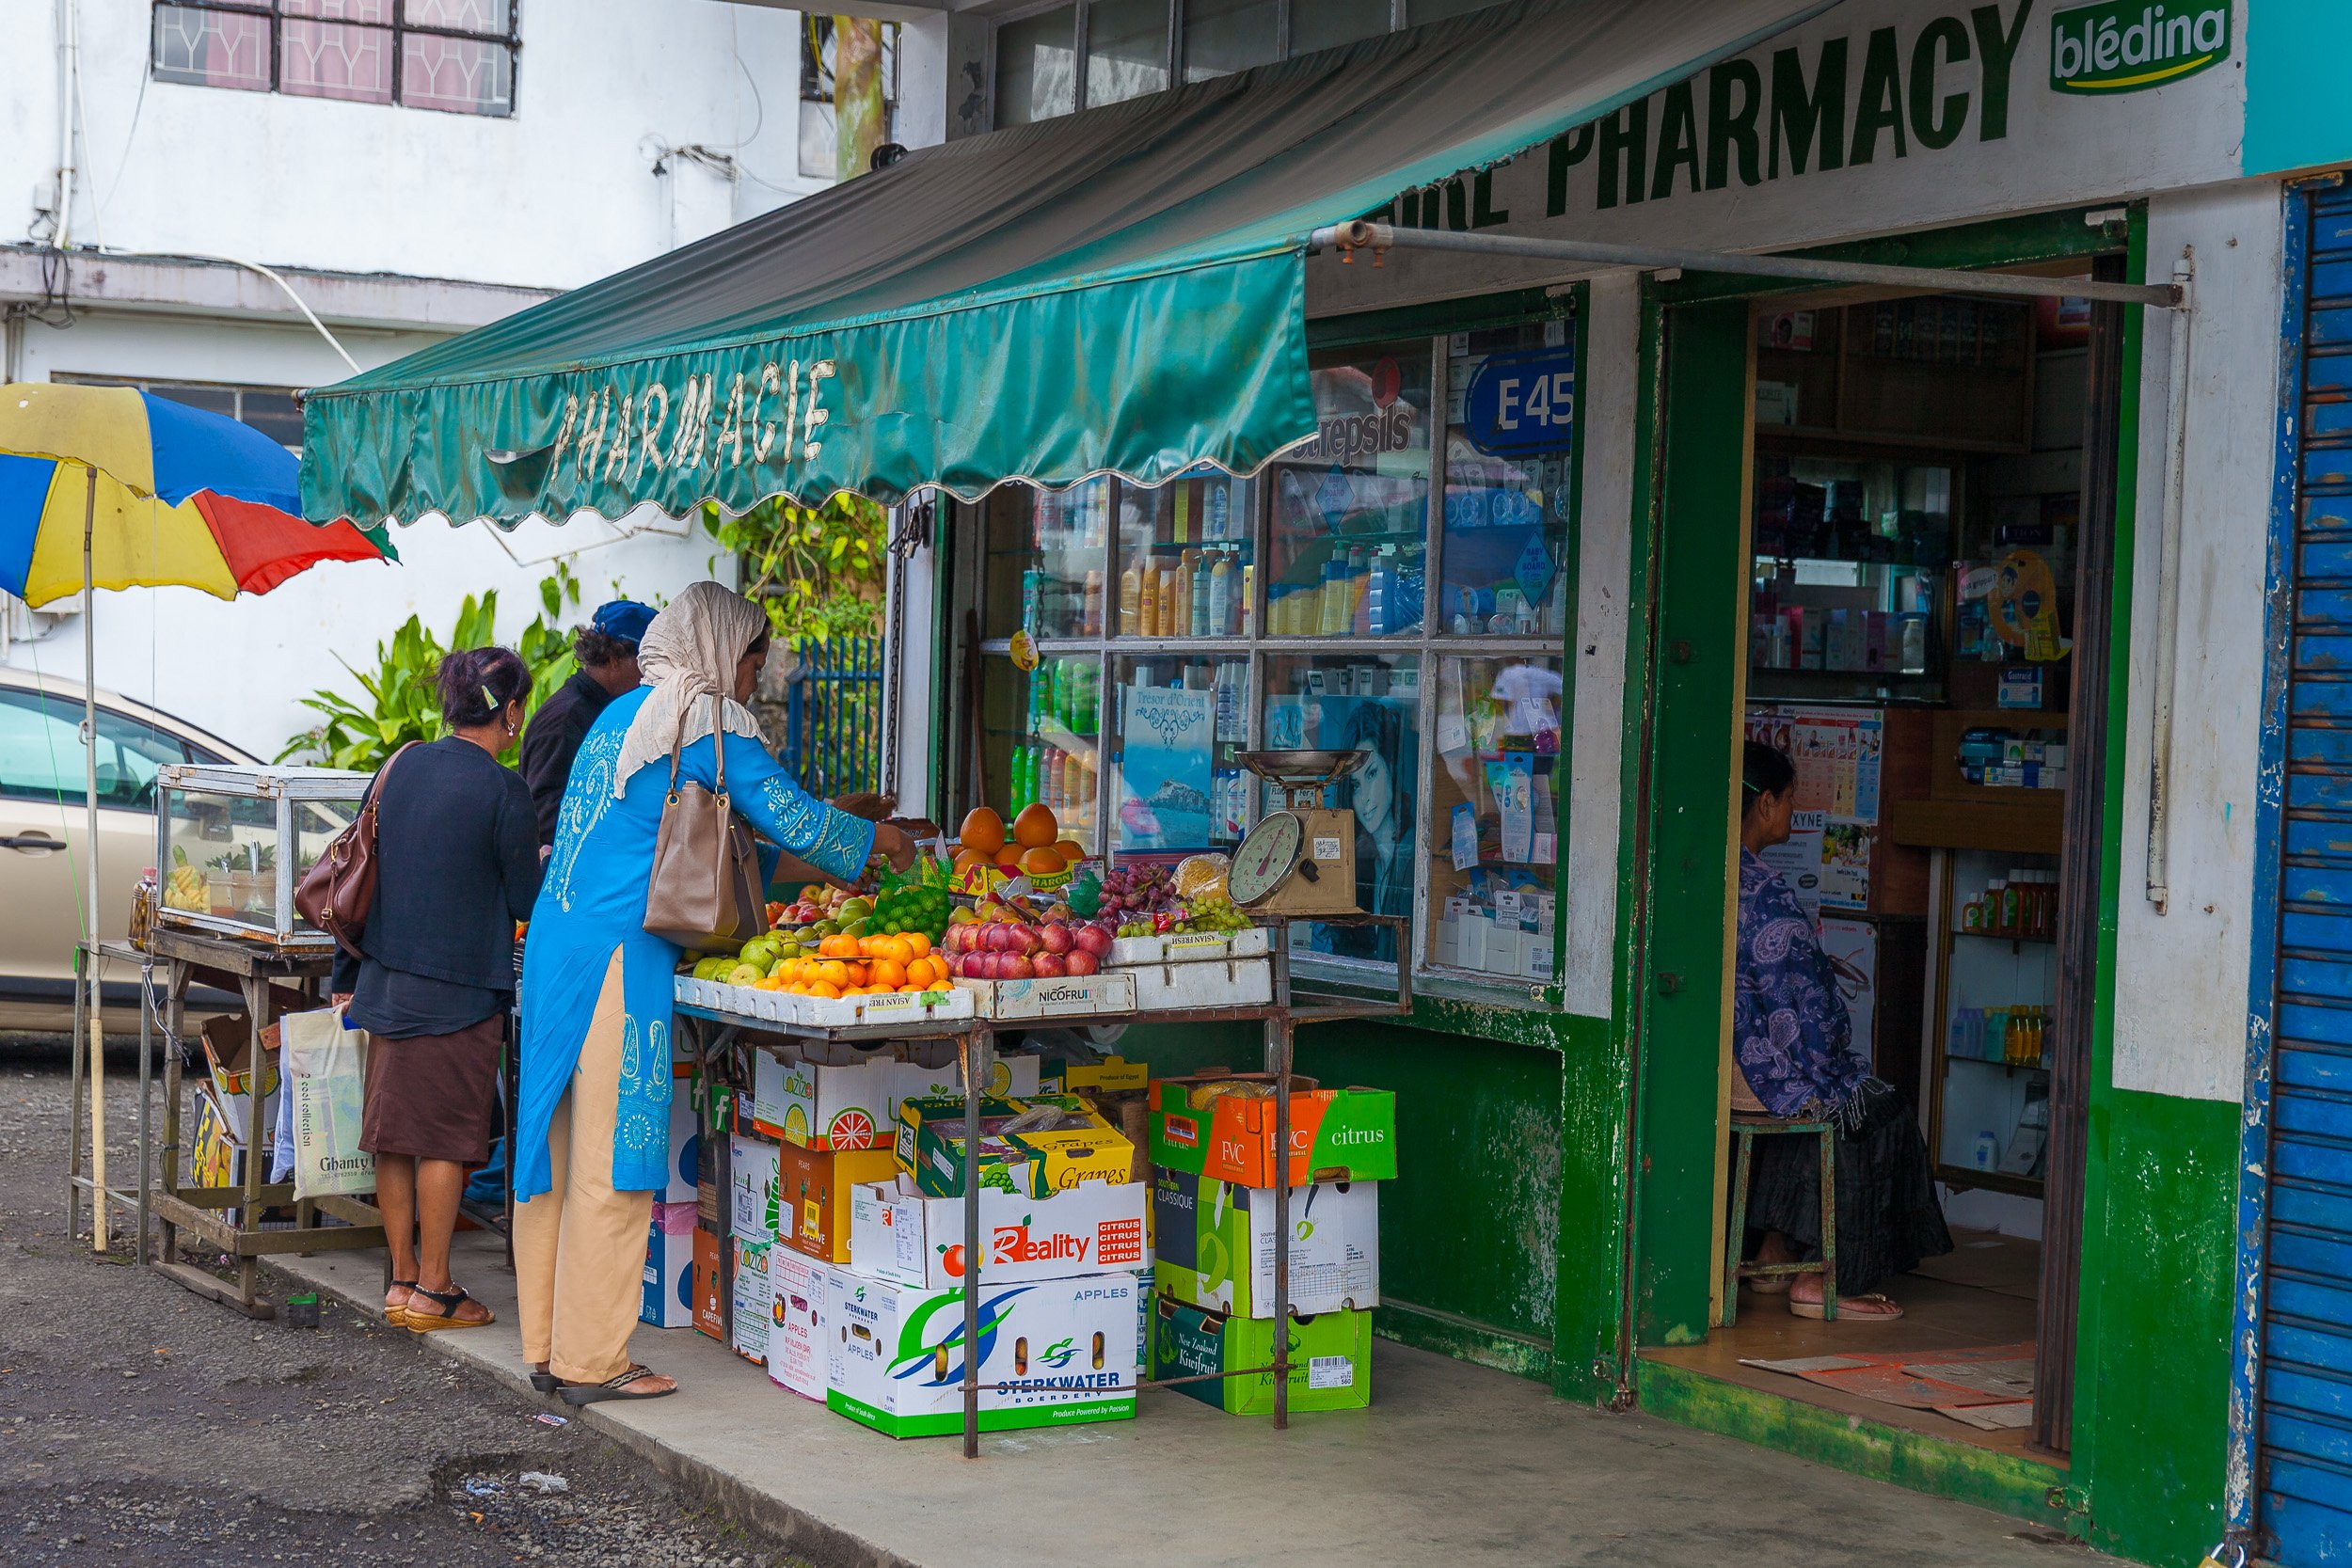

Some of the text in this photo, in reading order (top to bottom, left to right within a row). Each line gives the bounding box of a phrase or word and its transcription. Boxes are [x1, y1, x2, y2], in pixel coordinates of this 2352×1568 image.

[2055, 5, 2226, 78] blédina
[1547, 0, 2032, 218] PHARMACY
[550, 359, 836, 484] PHARMACIE
[1324, 489, 1344, 498] BOARD
[1526, 547, 1544, 556] BABY
[1521, 562, 1546, 571] BOARD
[1167, 692, 1205, 707] d'Orient
[1031, 873, 1071, 887] HARON
[1171, 935, 1216, 944] ASIAN FRESH
[886, 997, 911, 1006] ASIAN
[302, 1102, 312, 1147] collection
[1331, 1125, 1384, 1146] citrus
[1042, 1139, 1113, 1150] Grapes
[1221, 1140, 1245, 1165] FVC
[320, 1157, 368, 1172] Ghanty
[798, 1159, 811, 1172] PEARS
[1058, 1167, 1126, 1189] Grapes
[1157, 1188, 1194, 1210] CLASSIQUE
[1099, 1221, 1140, 1231] CITRUS
[1099, 1231, 1140, 1242] CITRUS
[994, 1228, 1090, 1263] Reality
[1099, 1242, 1140, 1252] CITRUS
[1099, 1252, 1140, 1261] CITRUS
[1074, 1288, 1128, 1301] APPLES
[844, 1301, 878, 1322] STERKWATER
[787, 1323, 808, 1338] APPLES
[848, 1343, 874, 1361] APPLES
[1178, 1333, 1217, 1356] New Zealand
[1178, 1349, 1217, 1375] Kiwifruit
[996, 1372, 1120, 1396] STERKWATER
[1015, 1391, 1103, 1403] BOERDERY
[1052, 1404, 1130, 1418] Produce Powered by Passion
